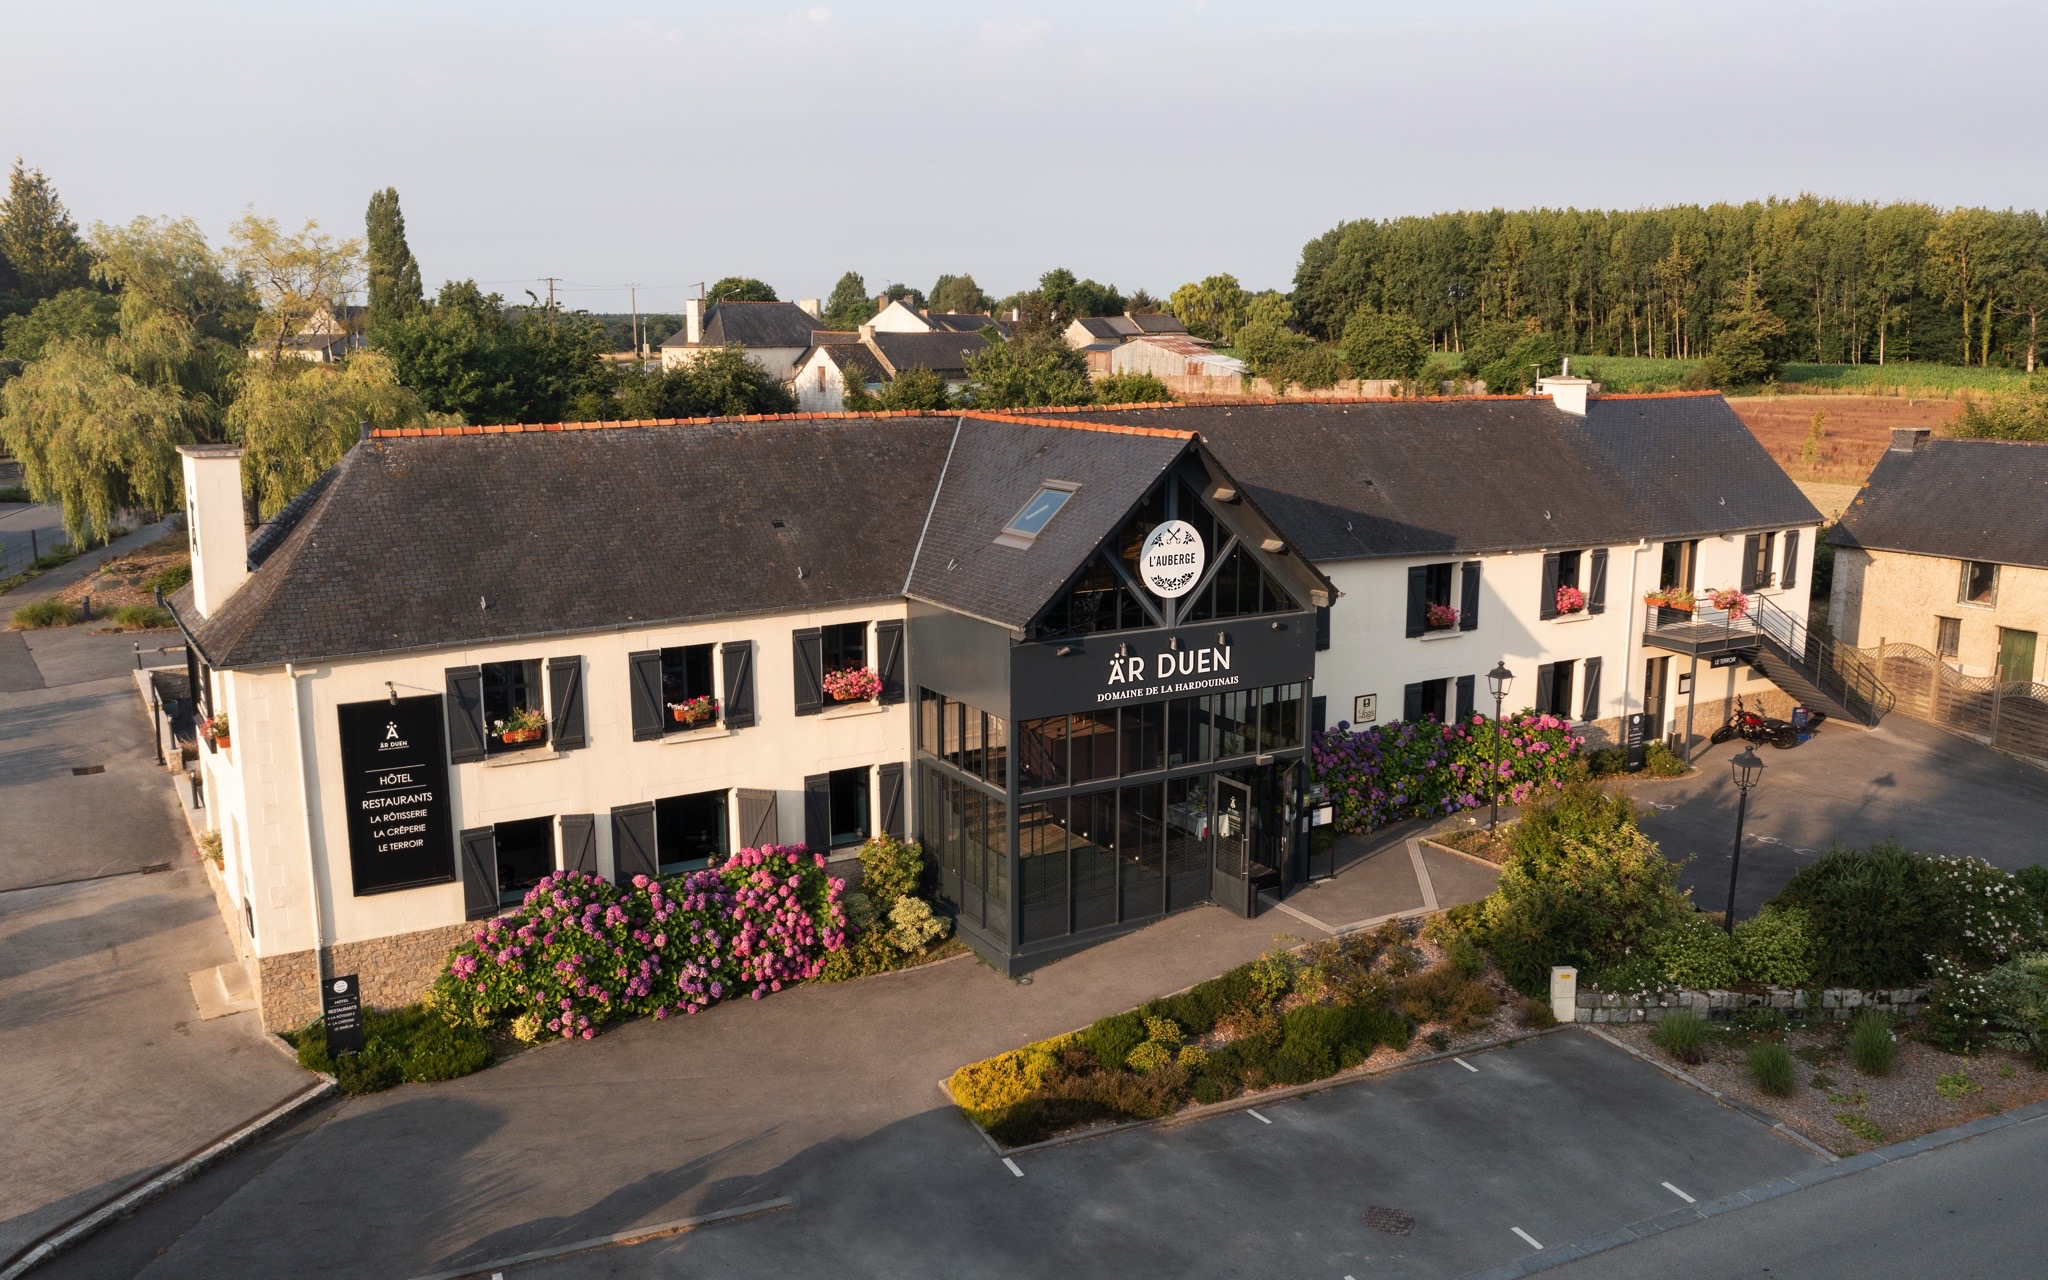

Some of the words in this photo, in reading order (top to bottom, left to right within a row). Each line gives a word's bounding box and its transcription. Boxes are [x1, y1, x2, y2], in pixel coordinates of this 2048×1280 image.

[1150, 553, 1195, 567] L'AUBERGE
[1108, 653, 1144, 684] ÄR
[1158, 646, 1230, 678] DUEN
[1098, 689, 1143, 702] DOMAINE
[1146, 687, 1158, 695] DE
[1161, 685, 1173, 693] LA
[1175, 676, 1238, 691] HARDOUINAIS
[390, 740, 408, 748] DUEN
[380, 774, 412, 785] HÔTEL
[363, 792, 432, 809] RESTAURANTS
[384, 809, 427, 821] RÔTISSERIE
[374, 830, 385, 838] LA
[387, 824, 426, 836] CRÊPERIE
[379, 844, 387, 852] LE
[390, 839, 423, 850] TERROIR
